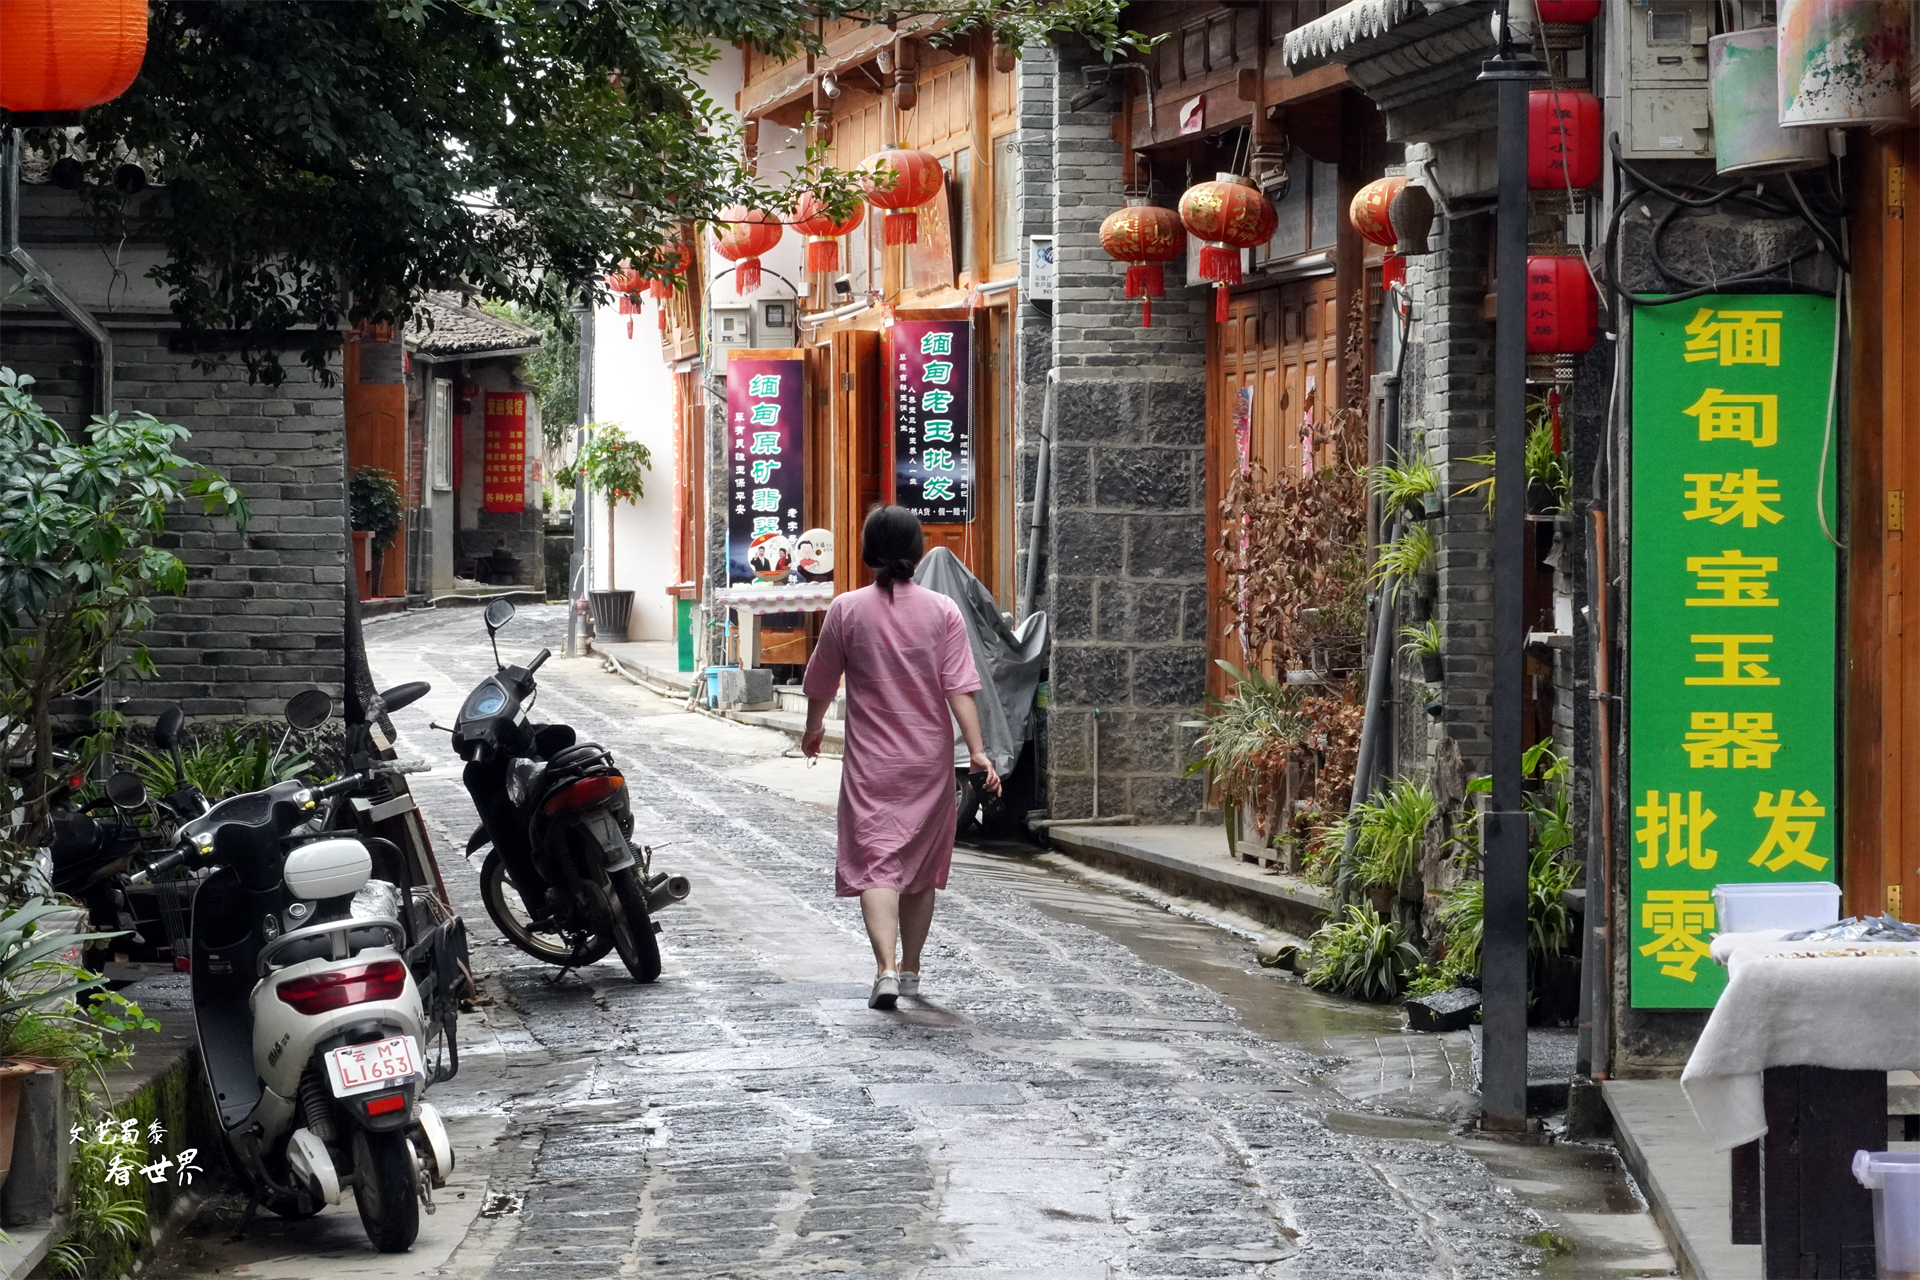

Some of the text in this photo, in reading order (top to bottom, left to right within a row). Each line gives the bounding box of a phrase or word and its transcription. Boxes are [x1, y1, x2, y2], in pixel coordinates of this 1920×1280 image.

[1547, 108, 1574, 170] 雅致小居
[1530, 274, 1554, 336] 雅致小居
[920, 331, 956, 502] 缅甸老玉批发
[749, 373, 782, 585] 缅甸原矿翡翠
[905, 507, 967, 517] 然A货·假一赔十
[1682, 308, 1786, 769] 缅甸珠宝玉器
[1635, 789, 1830, 872] 批发
[343, 1057, 408, 1084] L1653
[377, 1045, 392, 1058] M
